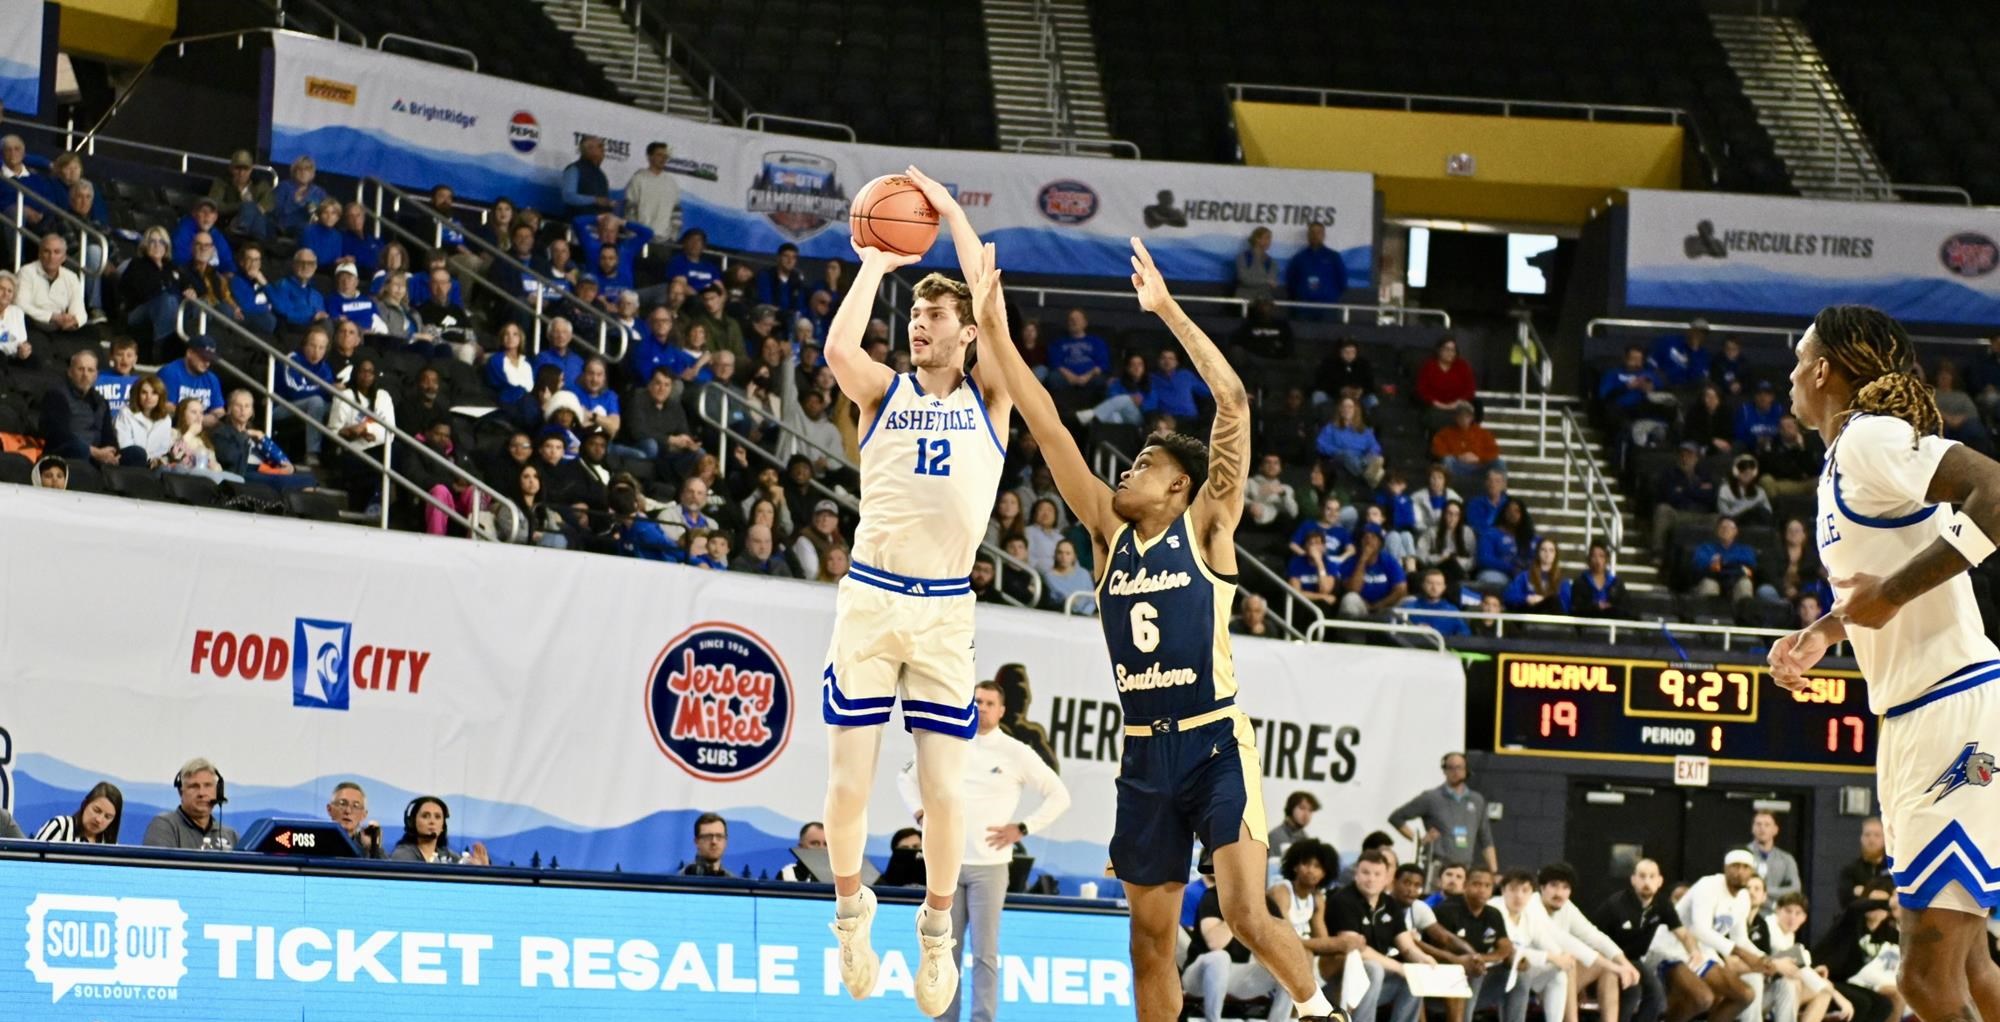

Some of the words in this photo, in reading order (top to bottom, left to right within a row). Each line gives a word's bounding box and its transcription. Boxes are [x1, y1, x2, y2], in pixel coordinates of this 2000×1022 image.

[409, 101, 478, 129] BrightRidge
[510, 124, 539, 138] PEPSI
[1184, 199, 1278, 224] HERCULES
[1283, 204, 1337, 227] TIRES
[1724, 228, 1818, 256] HERCULES
[1821, 236, 1875, 259] TIRES
[885, 408, 976, 431] ASHEVILLE
[914, 437, 951, 476] 12
[1129, 601, 1161, 653] 6
[190, 629, 290, 681] FOOD
[352, 644, 431, 693] CITY
[699, 639, 724, 650] SINCE
[727, 641, 750, 656] 1956
[667, 648, 775, 713] Jersey
[1115, 661, 1198, 693] Southern
[1510, 662, 1617, 692] UNCAVL
[1659, 669, 1749, 712] 9:27
[1791, 677, 1846, 705] CSU
[671, 692, 772, 747] Mike's
[1540, 701, 1578, 737] 19
[1827, 716, 1864, 753] 17
[1251, 718, 1361, 783] TIRES
[1641, 726, 1696, 746] PERIOD
[697, 747, 738, 767] SUBS
[1677, 760, 1707, 782] EXIT
[291, 832, 316, 848] POSS
[47, 920, 111, 959] SOLD
[126, 924, 172, 960] OUT
[203, 923, 494, 986] TICKET
[520, 935, 800, 995] RESALE
[73, 984, 178, 1001] SOLDOUT.COM
